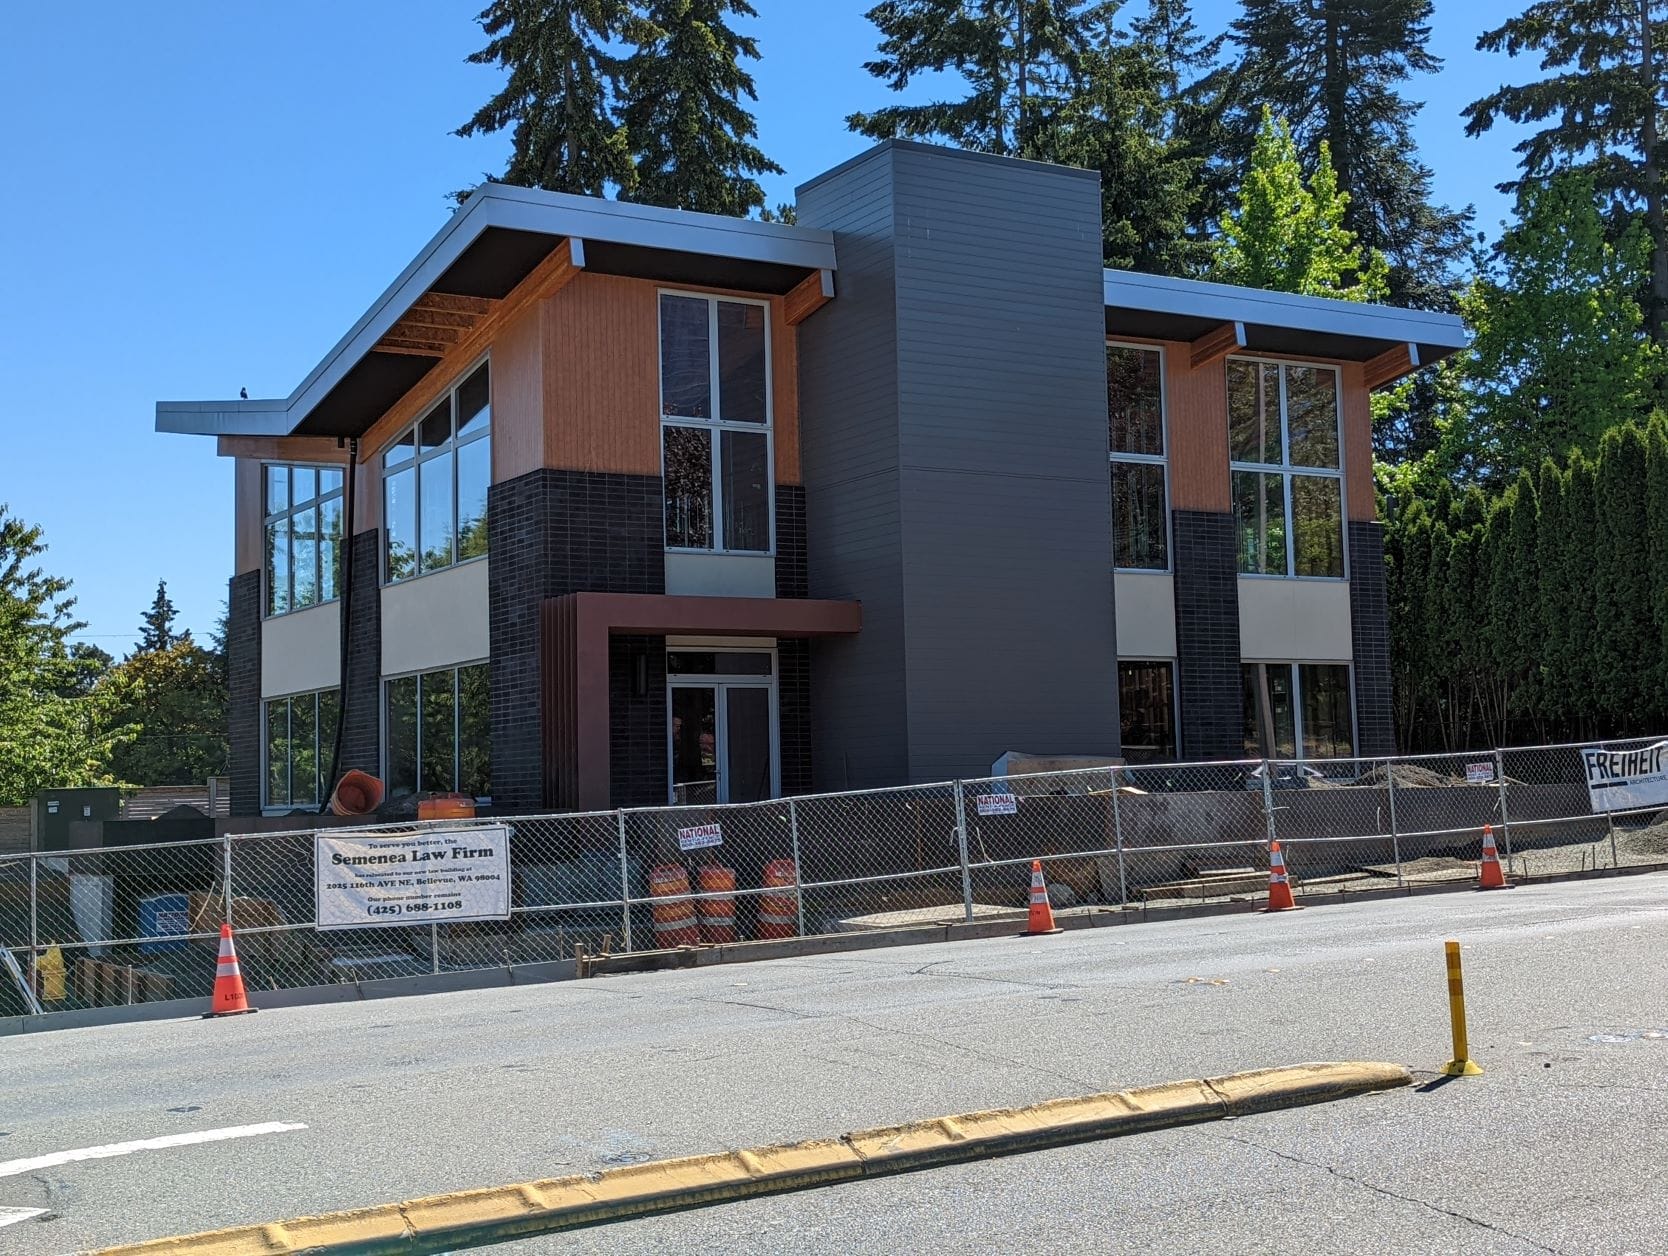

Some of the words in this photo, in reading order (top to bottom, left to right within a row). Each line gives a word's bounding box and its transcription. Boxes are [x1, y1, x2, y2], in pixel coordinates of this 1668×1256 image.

[1585, 746, 1663, 781] FREIHEIT
[978, 794, 1014, 805] NATIONAL
[680, 825, 719, 839] NATIONAL
[332, 853, 406, 865] Semenea
[411, 850, 447, 862] Law
[451, 847, 494, 860] Firm
[376, 880, 397, 888] AVE
[416, 877, 456, 885] Bellevue,
[474, 874, 501, 882] 98004
[367, 904, 402, 916] (425)
[405, 900, 462, 912] 688-1108
